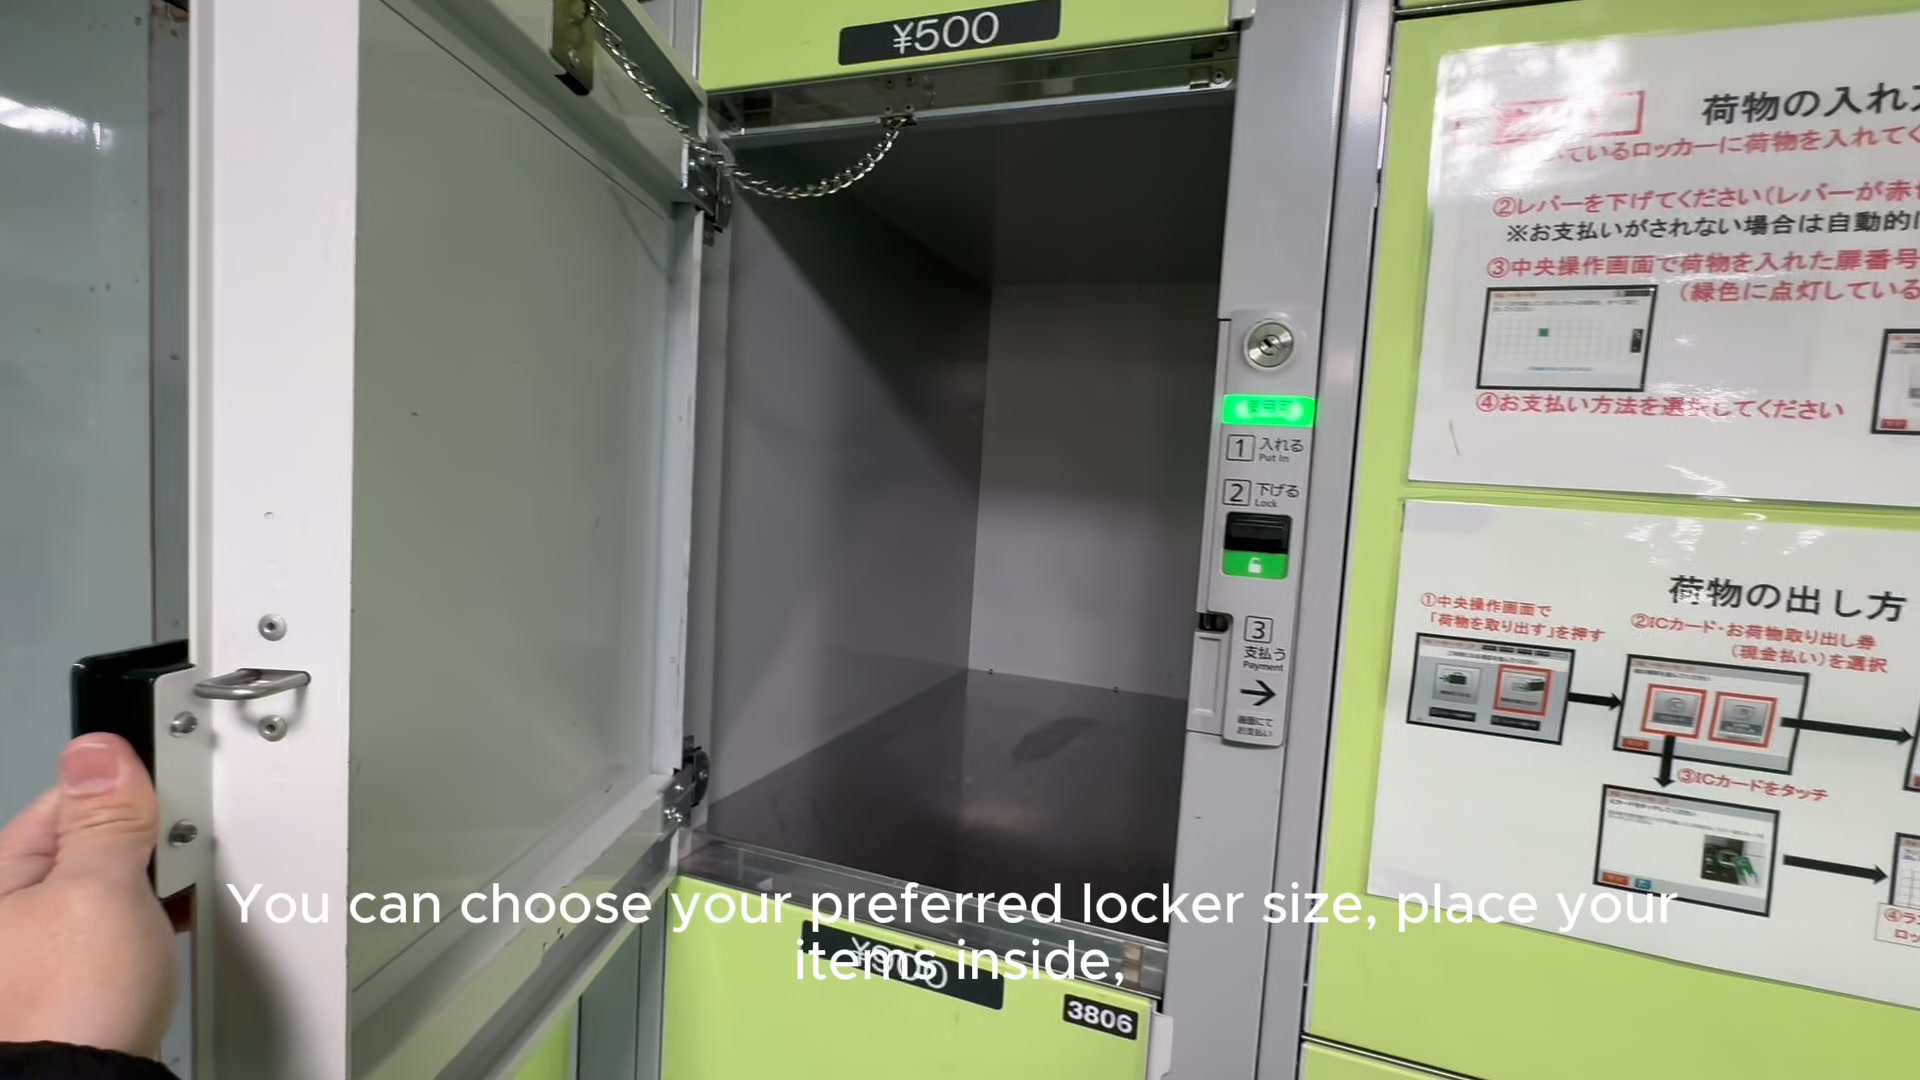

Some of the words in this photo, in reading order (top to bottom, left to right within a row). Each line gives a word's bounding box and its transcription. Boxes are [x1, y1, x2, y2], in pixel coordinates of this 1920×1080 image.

[893, 11, 1000, 55] ¥500
[1702, 82, 1920, 126] 荷物の入れ
[1235, 438, 1244, 458] 1
[1259, 437, 1304, 453] 入れる
[1259, 453, 1276, 462] Put
[1230, 483, 1244, 503] 2
[1256, 482, 1300, 498] 下げる
[1255, 498, 1279, 508] Lock
[1668, 574, 1907, 622] 荷物の出し方
[1251, 620, 1266, 640] 3
[1243, 645, 1287, 662] 支払う
[1242, 660, 1284, 672] Payment
[1067, 1000, 1133, 1034] 3806
